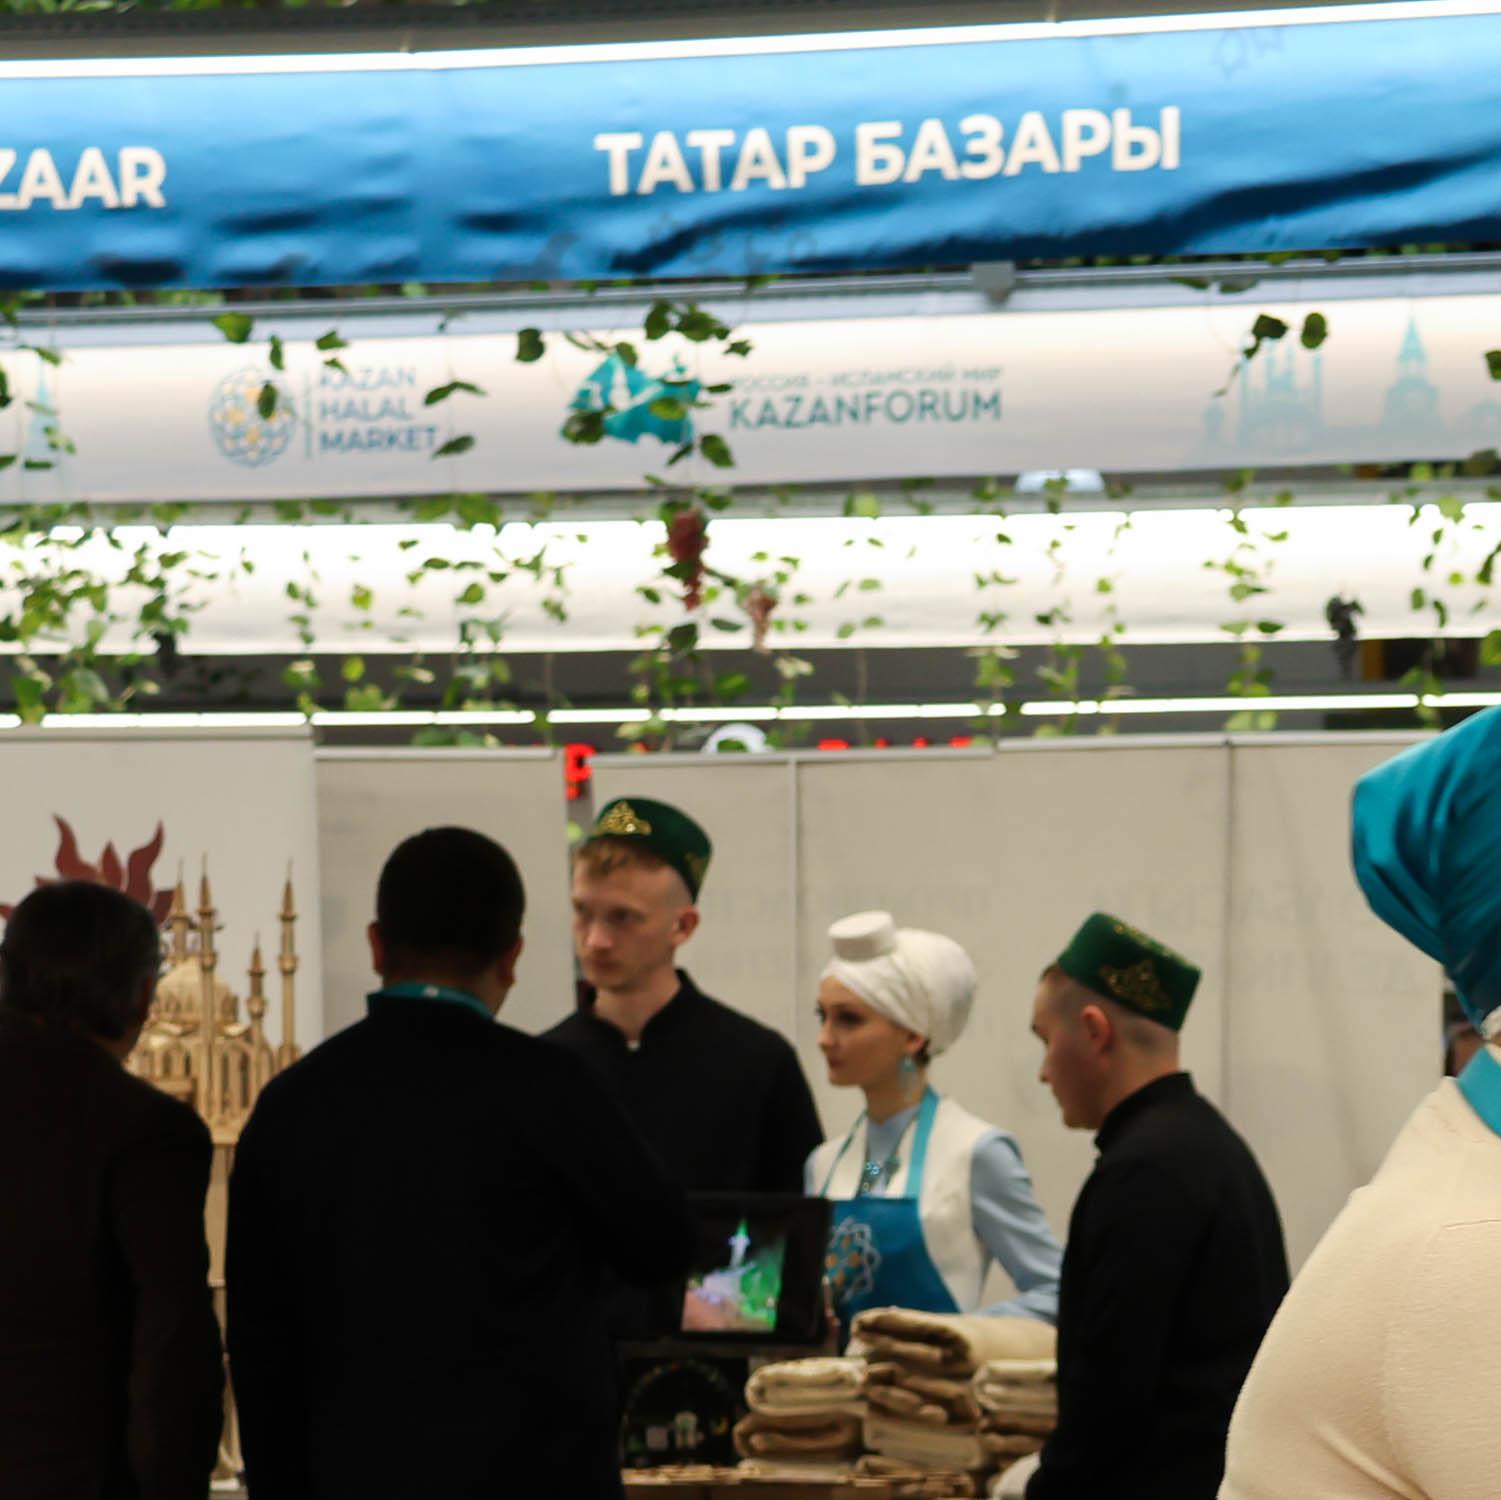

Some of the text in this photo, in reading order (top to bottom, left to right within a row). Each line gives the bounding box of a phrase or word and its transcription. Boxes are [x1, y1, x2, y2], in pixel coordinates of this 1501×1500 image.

[593, 106, 1180, 196] ТАТАР БАЗАРЫ
[319, 397, 414, 422] HALAL
[729, 388, 1003, 430] KAZANFORUM
[319, 424, 439, 453] MARKET
